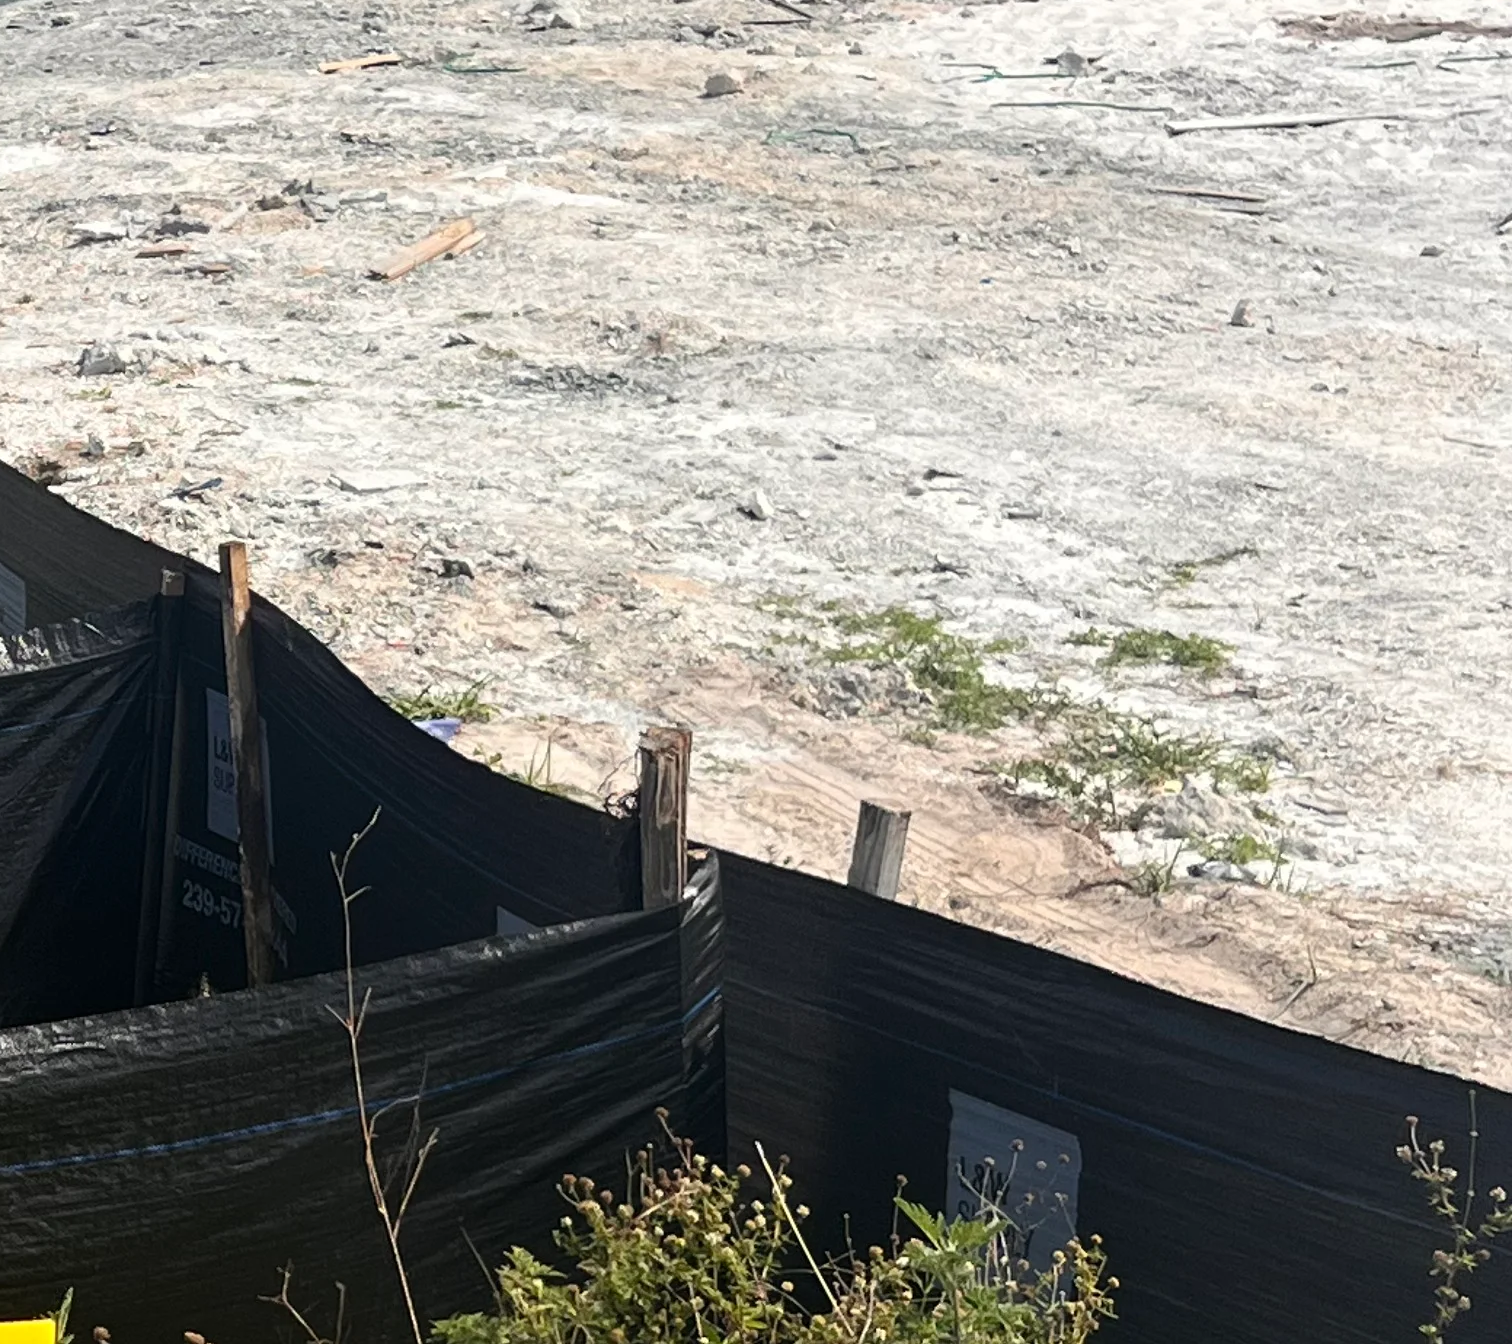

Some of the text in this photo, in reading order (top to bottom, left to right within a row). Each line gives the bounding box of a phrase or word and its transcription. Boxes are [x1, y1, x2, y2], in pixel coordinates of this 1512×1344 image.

[213, 766, 236, 795] SUP
[175, 834, 243, 885] DIFFERENC
[182, 880, 243, 929] 239-57
